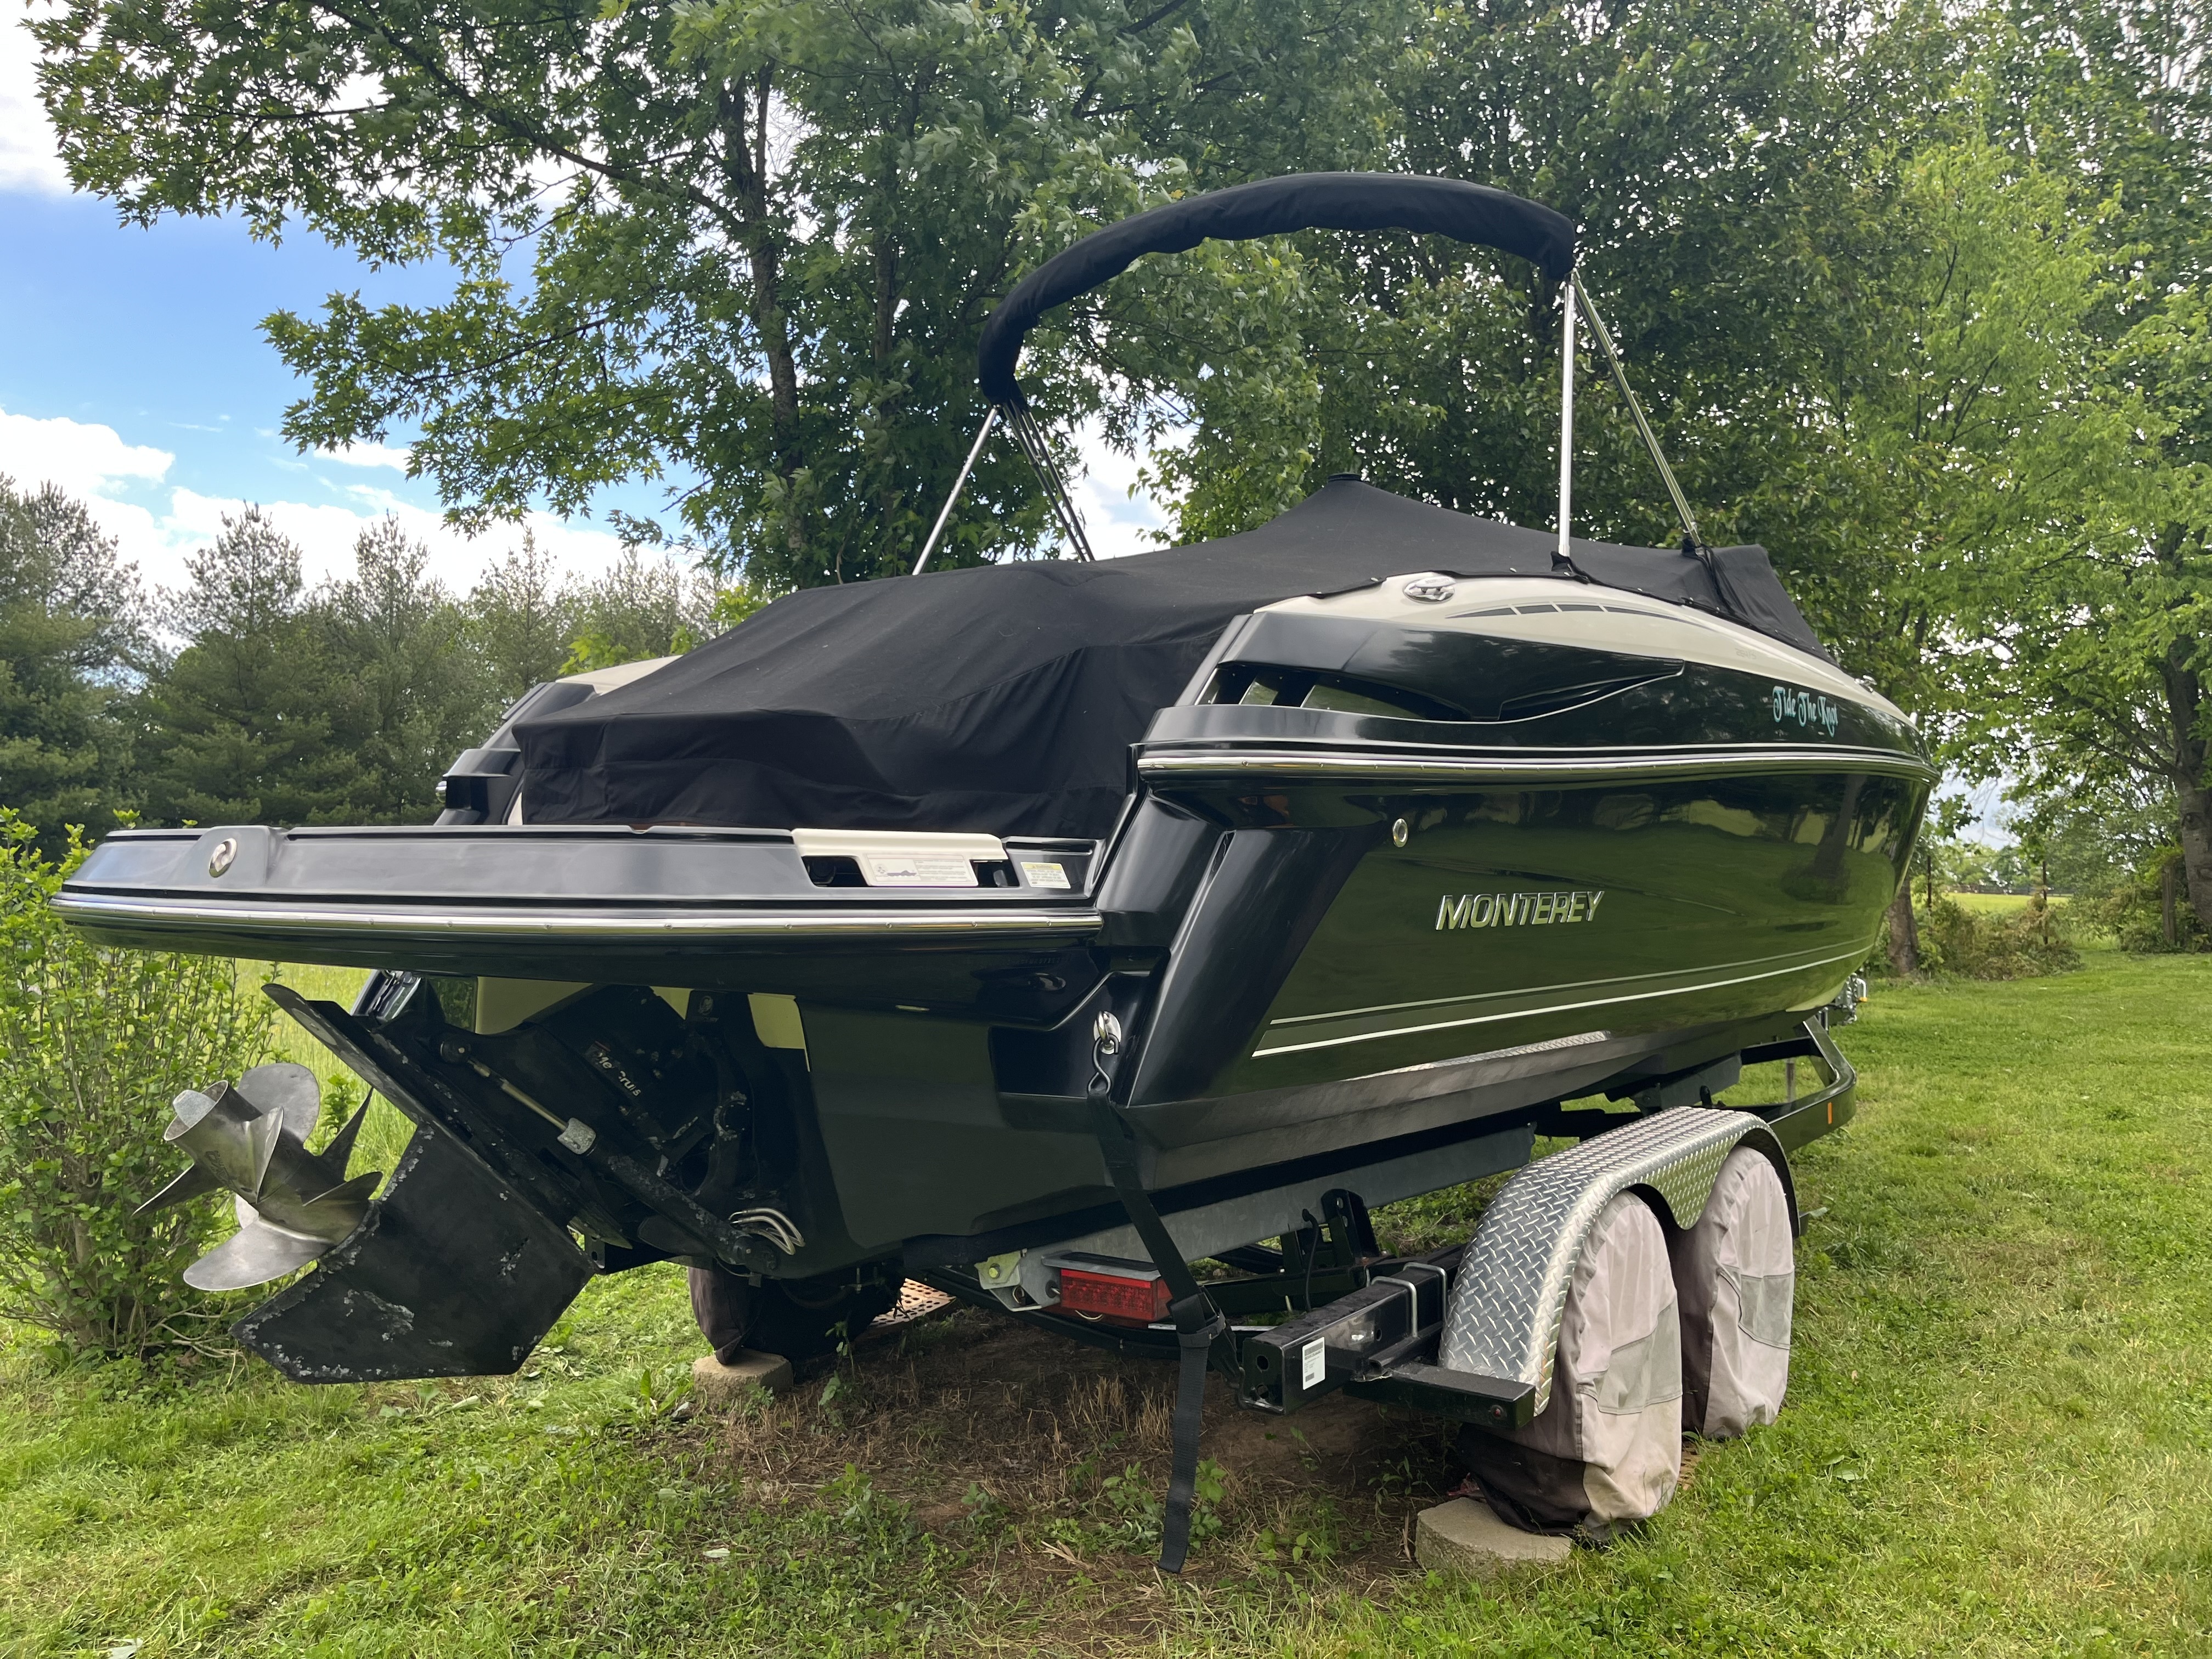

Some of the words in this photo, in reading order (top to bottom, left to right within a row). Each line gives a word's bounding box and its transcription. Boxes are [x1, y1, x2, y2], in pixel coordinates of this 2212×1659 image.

[1773, 686, 1796, 723] Tide
[1797, 692, 1817, 727] The
[1436, 891, 1605, 930] MONTEREY
